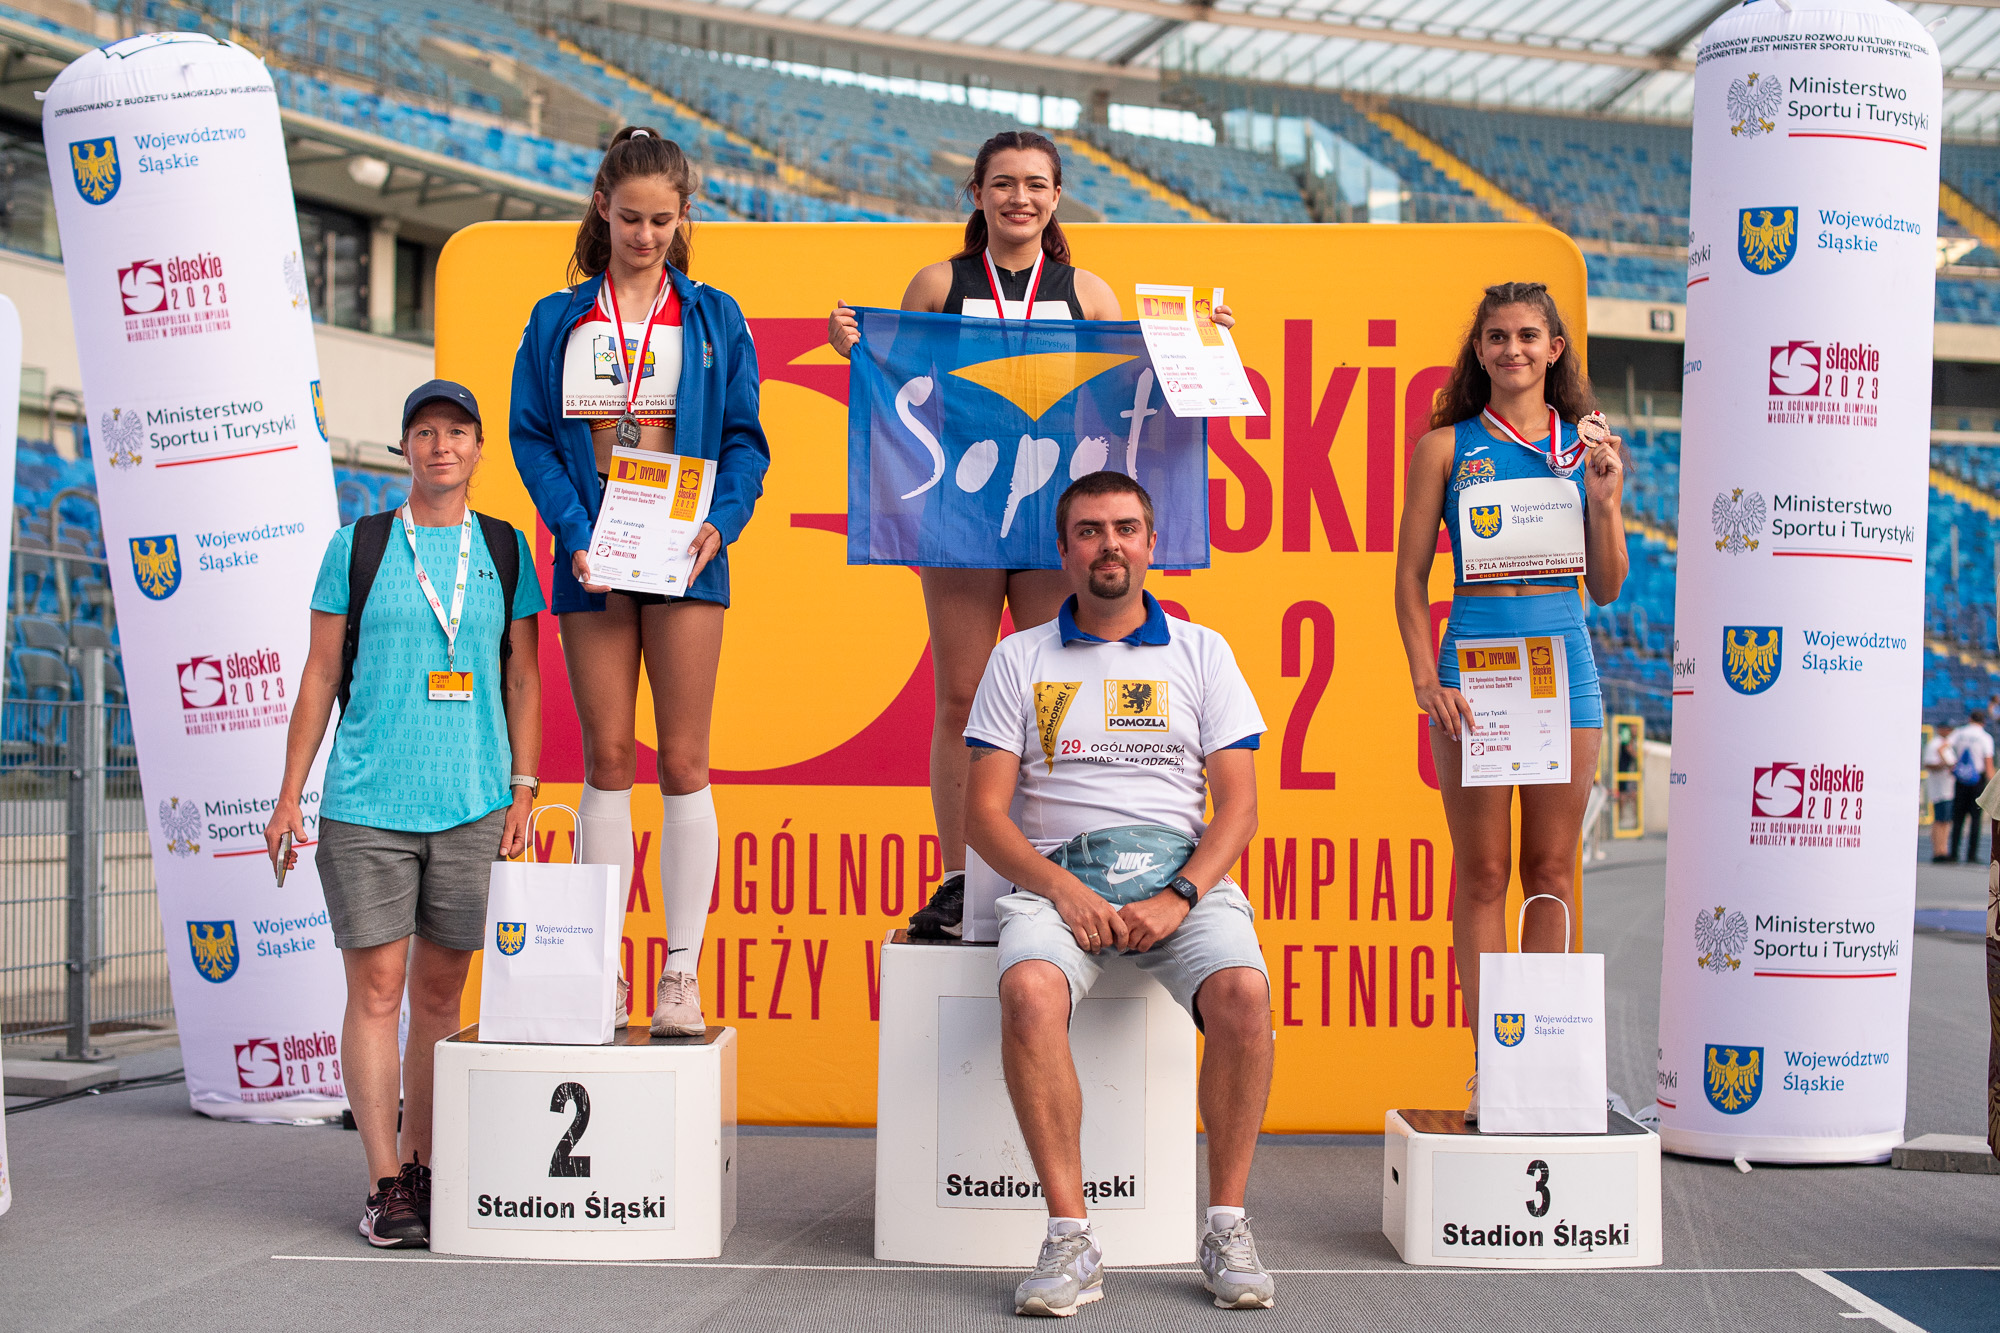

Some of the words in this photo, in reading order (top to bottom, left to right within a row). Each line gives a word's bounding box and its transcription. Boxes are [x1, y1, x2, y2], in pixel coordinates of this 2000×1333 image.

[1712, 36, 1749, 51] ŚRODKÓW
[1752, 34, 1801, 43] FUNDUSZU
[1805, 34, 1855, 42] ROZWOJU
[1857, 36, 1896, 47] KULTURY
[1749, 44, 1769, 53] JEST
[1773, 42, 1817, 51] MINISTER
[1820, 42, 1859, 52] SPORTU
[1789, 76, 1907, 101] Ministerstwo
[116, 99, 122, 107] Z
[1788, 101, 1851, 120] Sportu
[1857, 102, 1861, 118] i
[1866, 103, 1929, 131] Turystyki
[134, 126, 247, 151] Województwo
[139, 153, 199, 175] Śląskie
[1818, 209, 1921, 235] Województwo
[1817, 231, 1878, 253] Śląskie
[168, 252, 223, 284] śląskie
[171, 283, 227, 310] 2023
[1162, 301, 1184, 315] DYPLOM
[1826, 342, 1879, 372] śląskie
[1825, 374, 1878, 399] 2023
[146, 400, 263, 426] Ministerstwo
[566, 399, 577, 407] 55.
[580, 399, 597, 407] PZLA
[600, 398, 643, 407] Mistrzowa
[646, 398, 667, 407] Polski
[1768, 401, 1784, 411] XXIX
[1788, 399, 1840, 412] OGÓLNOPOLSKA
[1845, 403, 1878, 414] OLIMPIADA
[1768, 412, 1804, 424] MŁODZIEŻY
[1808, 414, 1813, 424] W
[1817, 414, 1850, 425] SPORTACH
[1854, 416, 1877, 427] LETNICH
[150, 428, 209, 451] Sportu
[213, 426, 218, 441] i
[222, 413, 296, 440] Turystyki
[895, 367, 1157, 538] Sopot
[640, 466, 667, 483] DYPLOM
[1453, 476, 1496, 491] GDAŃSK
[675, 499, 695, 509] 2023
[1511, 501, 1573, 513] Województwo
[1773, 494, 1892, 516] Ministerstwo
[1512, 514, 1544, 525] Śląskie
[196, 521, 305, 548] Województwo
[1772, 519, 1836, 539] Sportu
[1842, 521, 1846, 537] i
[1851, 521, 1914, 544] Turystyki
[199, 551, 260, 573] Śląskie
[1465, 563, 1477, 571] 55.
[1479, 561, 1497, 570] PZLA
[1500, 560, 1543, 569] Mistrzostwa
[1546, 557, 1568, 566] Polski
[1570, 556, 1584, 564] U18
[1803, 630, 1907, 650] Województwo
[227, 648, 281, 681] śląskie
[1489, 652, 1517, 665] DYPLOM
[1802, 653, 1863, 674] Śląskie
[230, 677, 285, 705] 2023
[1533, 676, 1552, 685] 2023
[1044, 691, 1067, 742] POMORSKI
[1061, 739, 1086, 755] 29.
[1091, 742, 1185, 753] OGÓLNOPOLSKA
[1810, 763, 1864, 794] śląskie
[1808, 796, 1862, 820] 2023
[207, 819, 265, 842] Sportu
[1751, 822, 1766, 833] XXIX
[1770, 821, 1822, 834] OGÓLNOPOLSKA
[1827, 824, 1861, 835] OLIMPIADA
[1750, 834, 1786, 846] MŁODZIEŻY
[1791, 836, 1796, 846] W
[1800, 836, 1832, 847] SPORTACH
[1836, 837, 1860, 848] LETNICH
[1114, 853, 1154, 870] NIKE
[535, 924, 594, 935] Województwo
[1755, 915, 1875, 934] Ministerstwo
[257, 936, 316, 958] Śląskie
[534, 935, 564, 946] Śląskie
[1754, 939, 1818, 959] Sportu
[1824, 941, 1828, 957] i
[1833, 940, 1899, 961] Turystyki
[1534, 1014, 1593, 1025] Województwo
[1534, 1025, 1565, 1036] Śląskie
[284, 1030, 337, 1062] śląskie
[1784, 1050, 1889, 1070] Województwo
[287, 1060, 341, 1086] 2023
[1783, 1072, 1844, 1095] Śląskie
[548, 1081, 591, 1177] 2
[946, 1174, 1045, 1198] Stadion
[1083, 1175, 1136, 1203] ąski
[1525, 1159, 1551, 1217] 3
[477, 1194, 575, 1219] Stadion
[584, 1191, 666, 1224] Śląski
[1442, 1222, 1543, 1246] Stadion
[1553, 1219, 1629, 1252] Śląski
